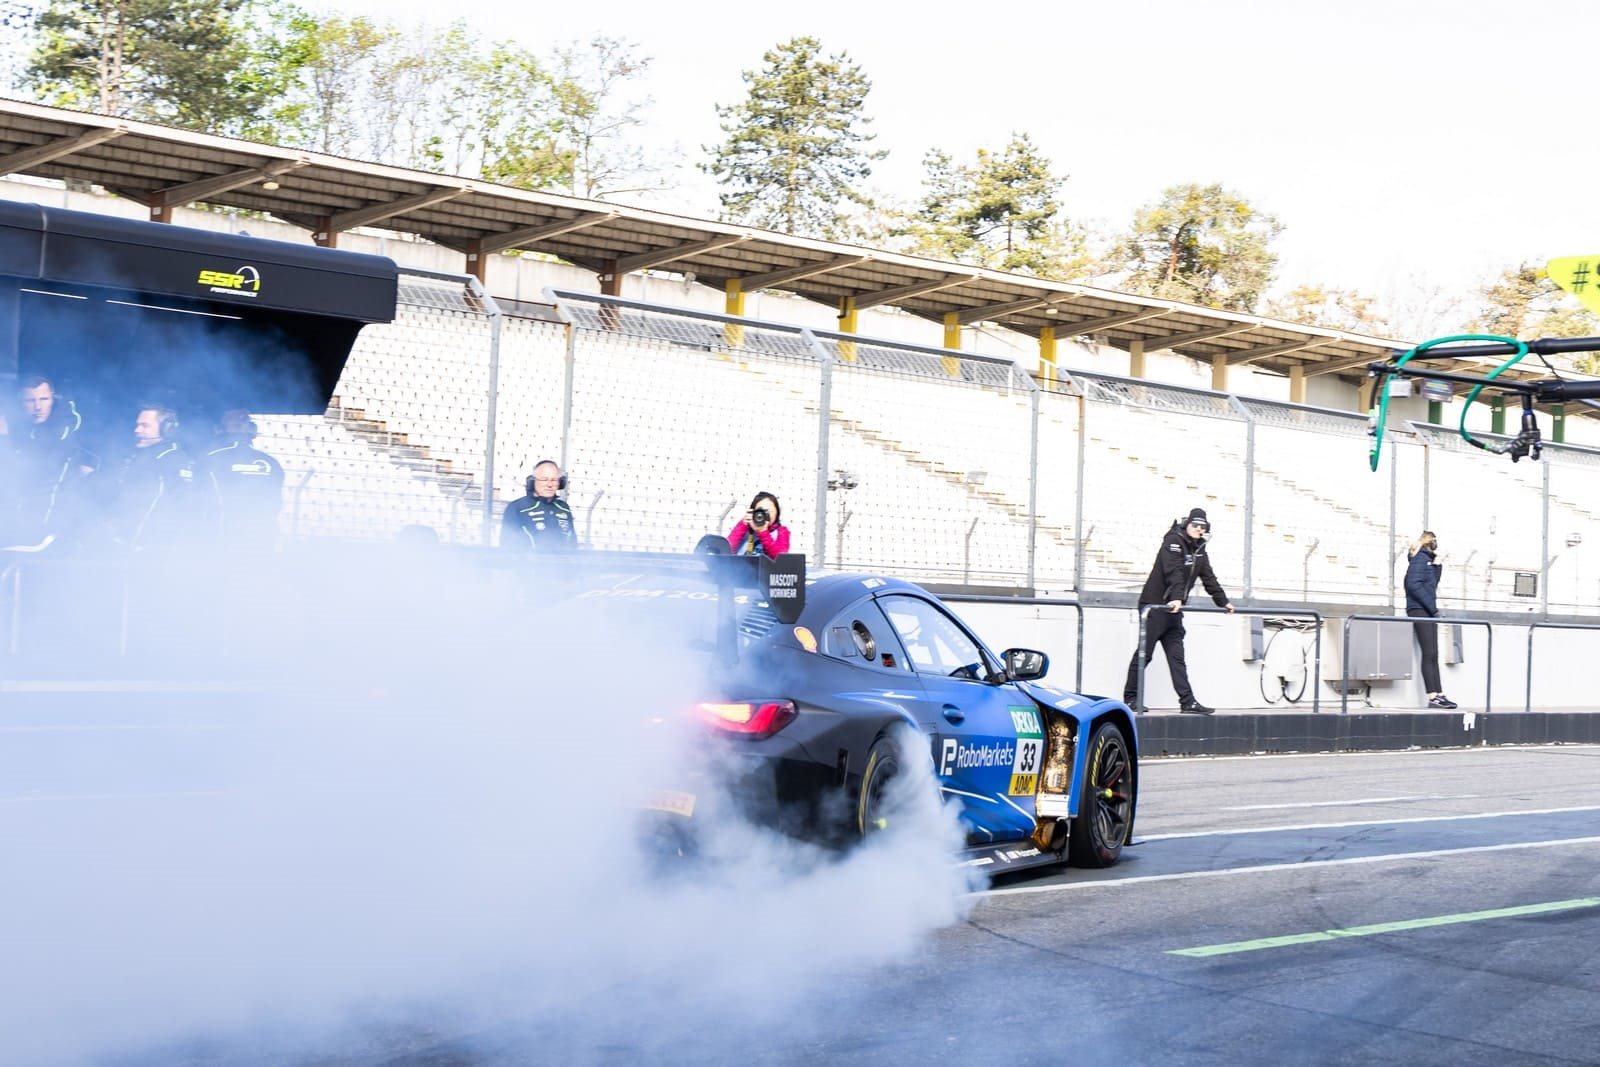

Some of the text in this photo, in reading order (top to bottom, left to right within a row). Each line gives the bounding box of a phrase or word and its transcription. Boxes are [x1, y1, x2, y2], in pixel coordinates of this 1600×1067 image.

[198, 270, 245, 289] SSR
[769, 588, 797, 598] WORKWEAR
[1010, 711, 1041, 734] DEKRA
[957, 741, 1014, 768] RoboMarkets
[1020, 743, 1036, 771] 33
[1014, 775, 1033, 794] ADAC
